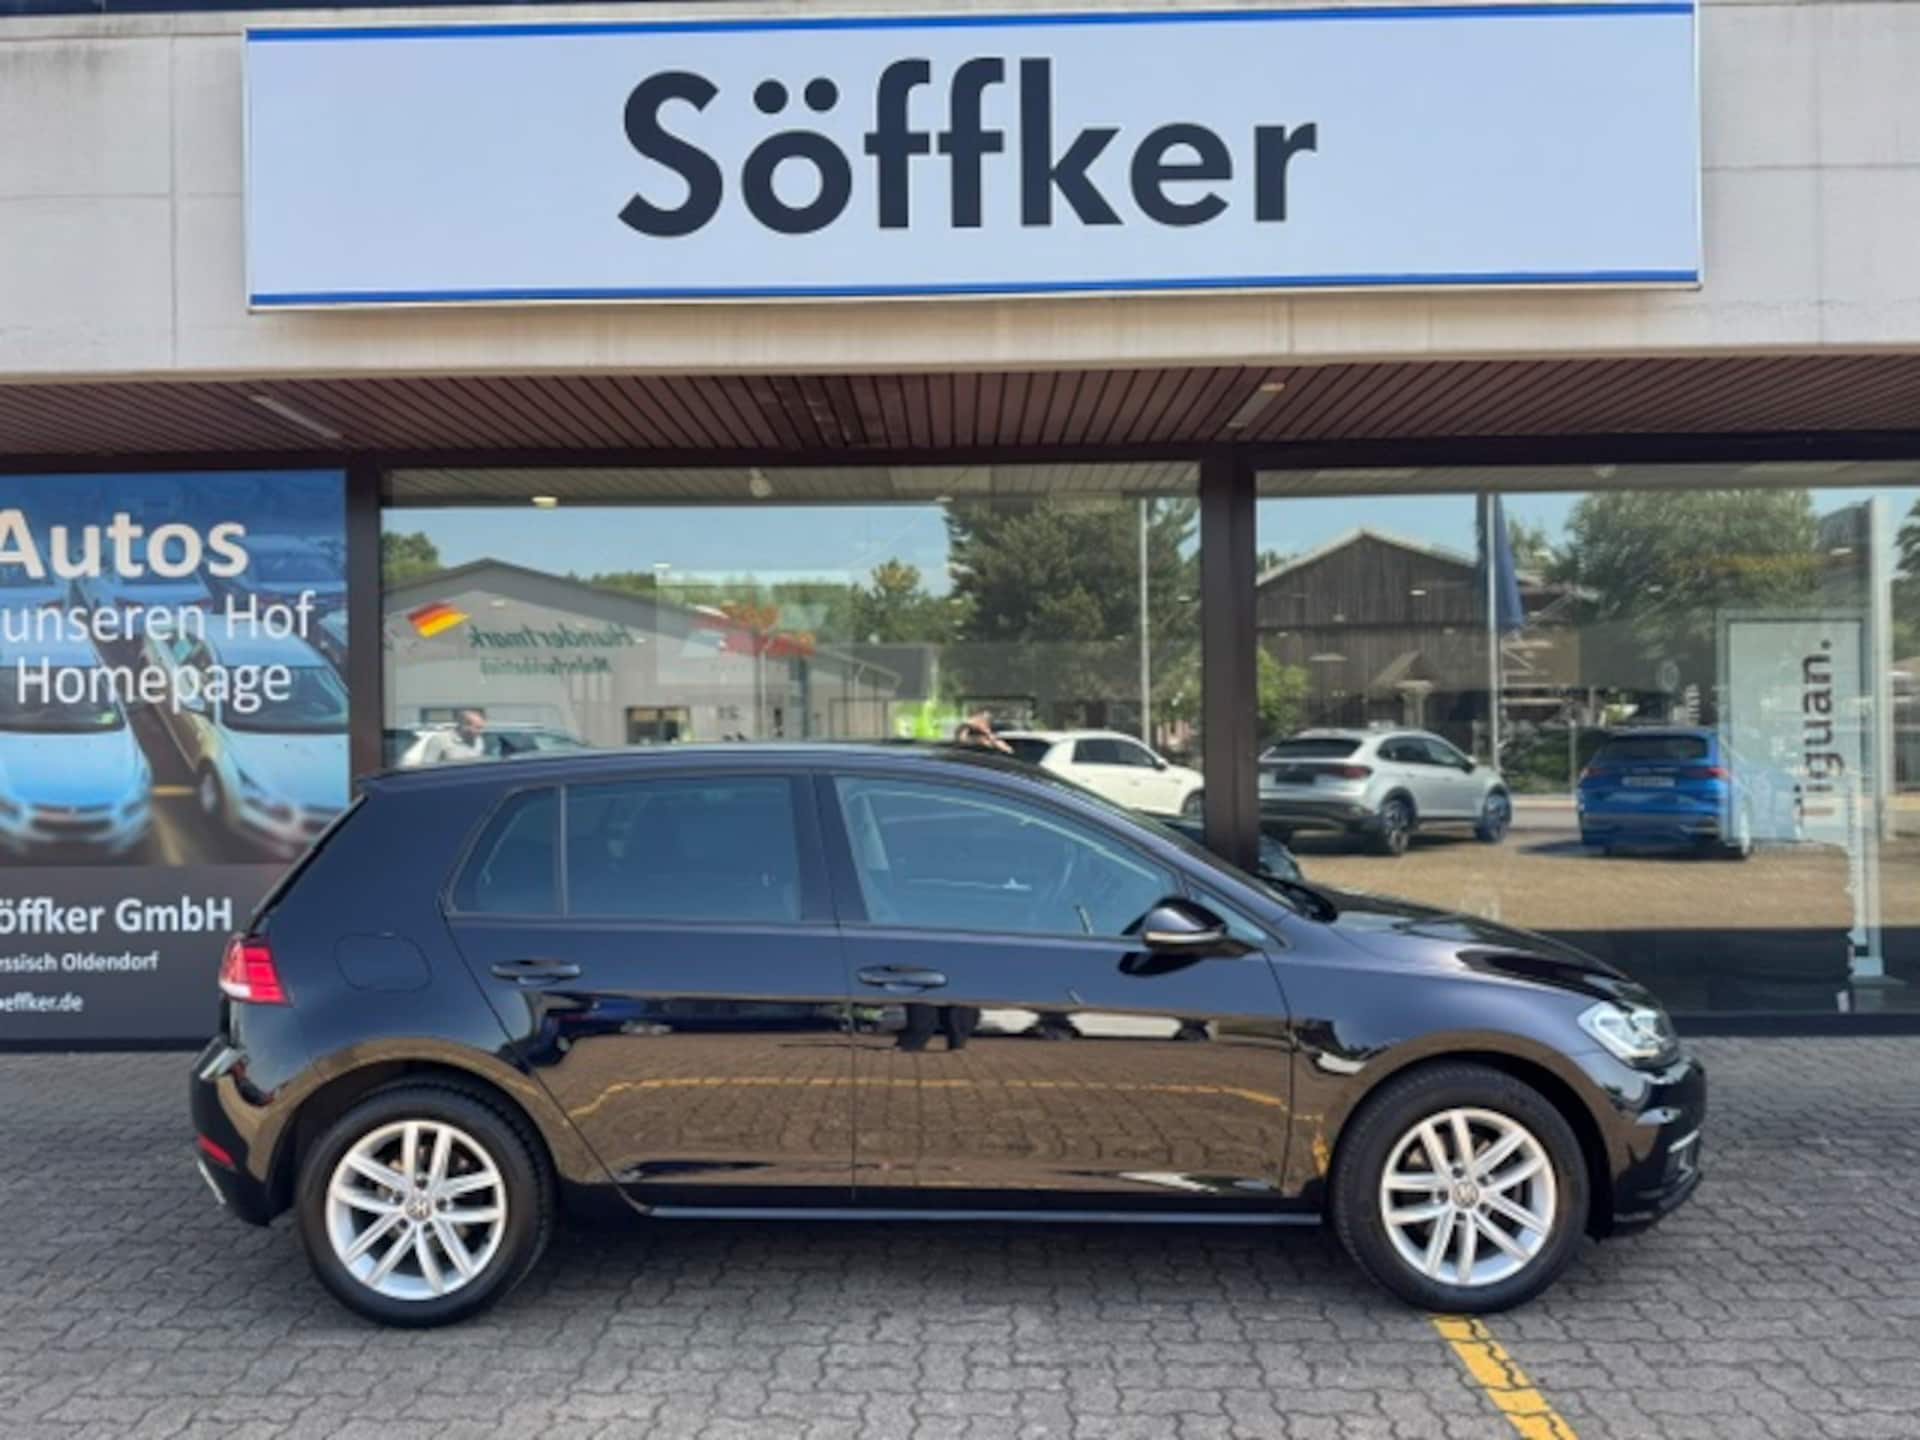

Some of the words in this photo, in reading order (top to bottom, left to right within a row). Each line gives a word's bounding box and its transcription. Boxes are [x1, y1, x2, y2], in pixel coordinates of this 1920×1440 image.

[617, 56, 1318, 238] Söffker
[0, 508, 249, 578] Autos
[4, 602, 206, 643] unseren
[226, 589, 316, 640] Hof
[16, 655, 292, 714] Homepage
[114, 895, 233, 933] GmbH
[61, 950, 160, 972] Oldendorf
